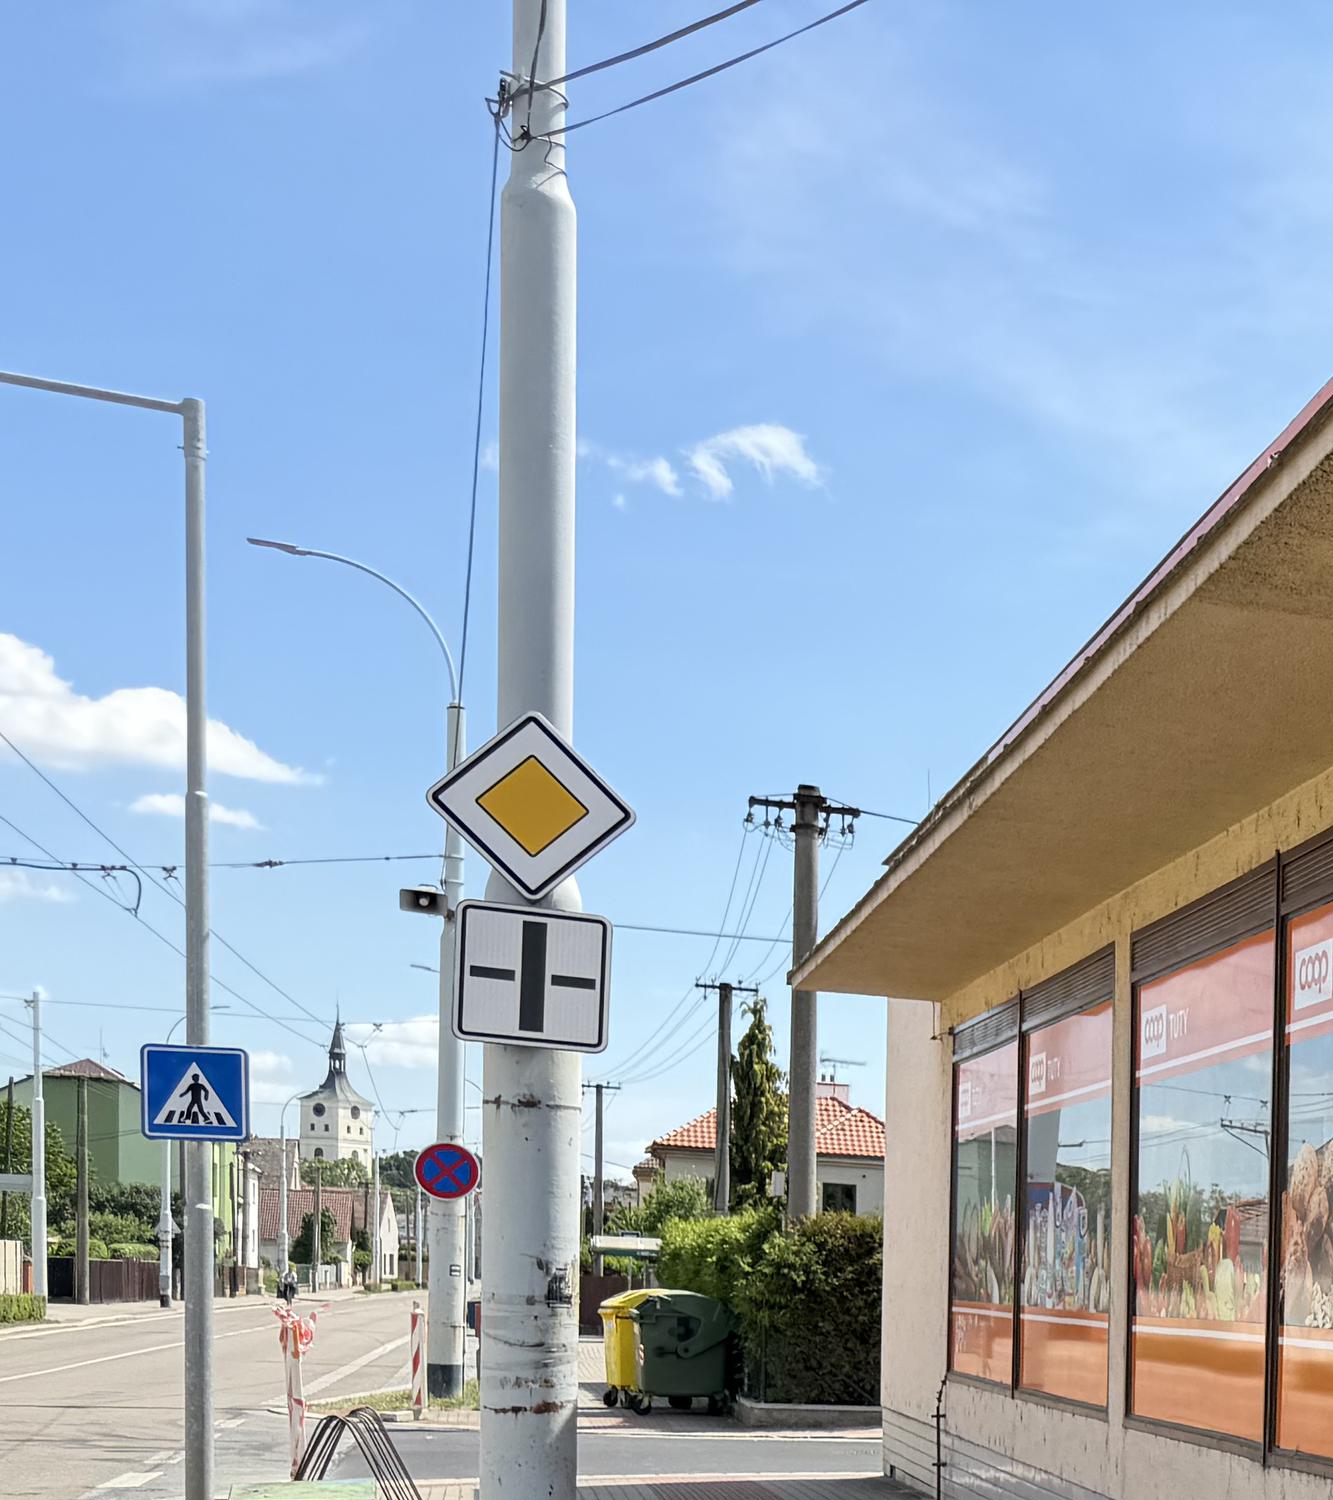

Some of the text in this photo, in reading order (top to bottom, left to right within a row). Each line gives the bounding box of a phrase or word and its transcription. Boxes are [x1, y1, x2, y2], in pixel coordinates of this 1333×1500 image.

[1300, 950, 1328, 993] coop
[1144, 1008, 1189, 1048] coop TUTY
